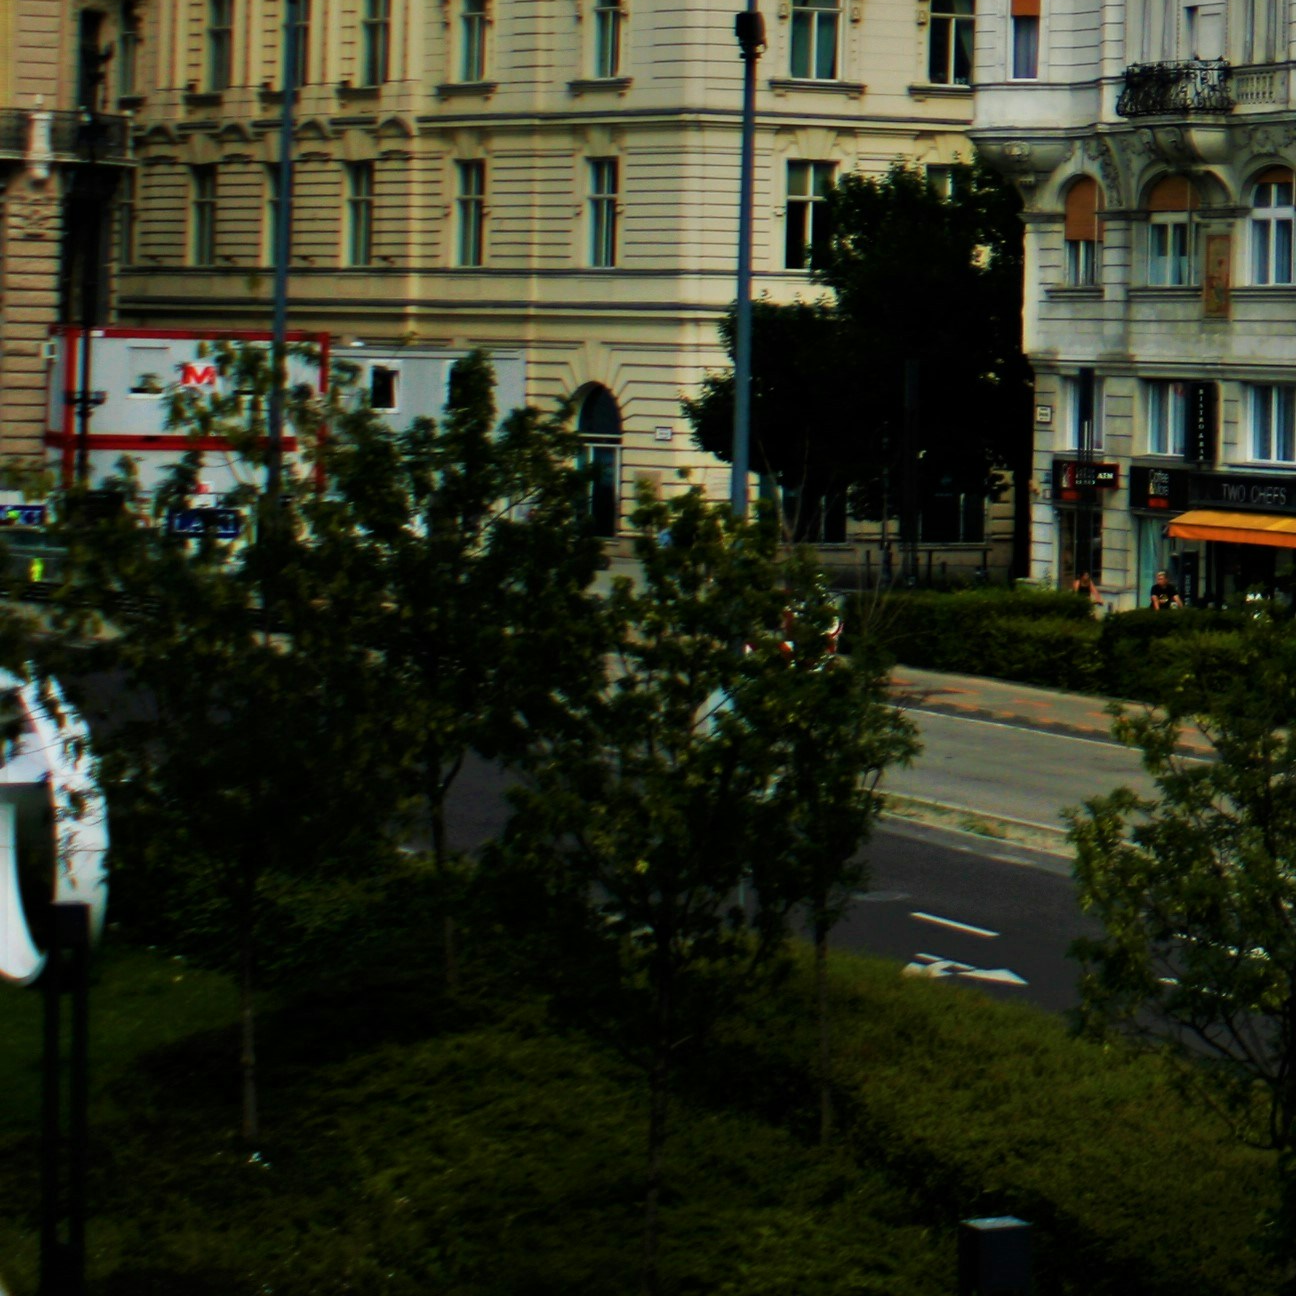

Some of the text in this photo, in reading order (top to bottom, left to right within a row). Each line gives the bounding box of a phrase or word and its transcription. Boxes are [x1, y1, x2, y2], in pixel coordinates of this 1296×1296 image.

[181, 364, 216, 386] M
[1222, 483, 1287, 505] TWO CHEFS
